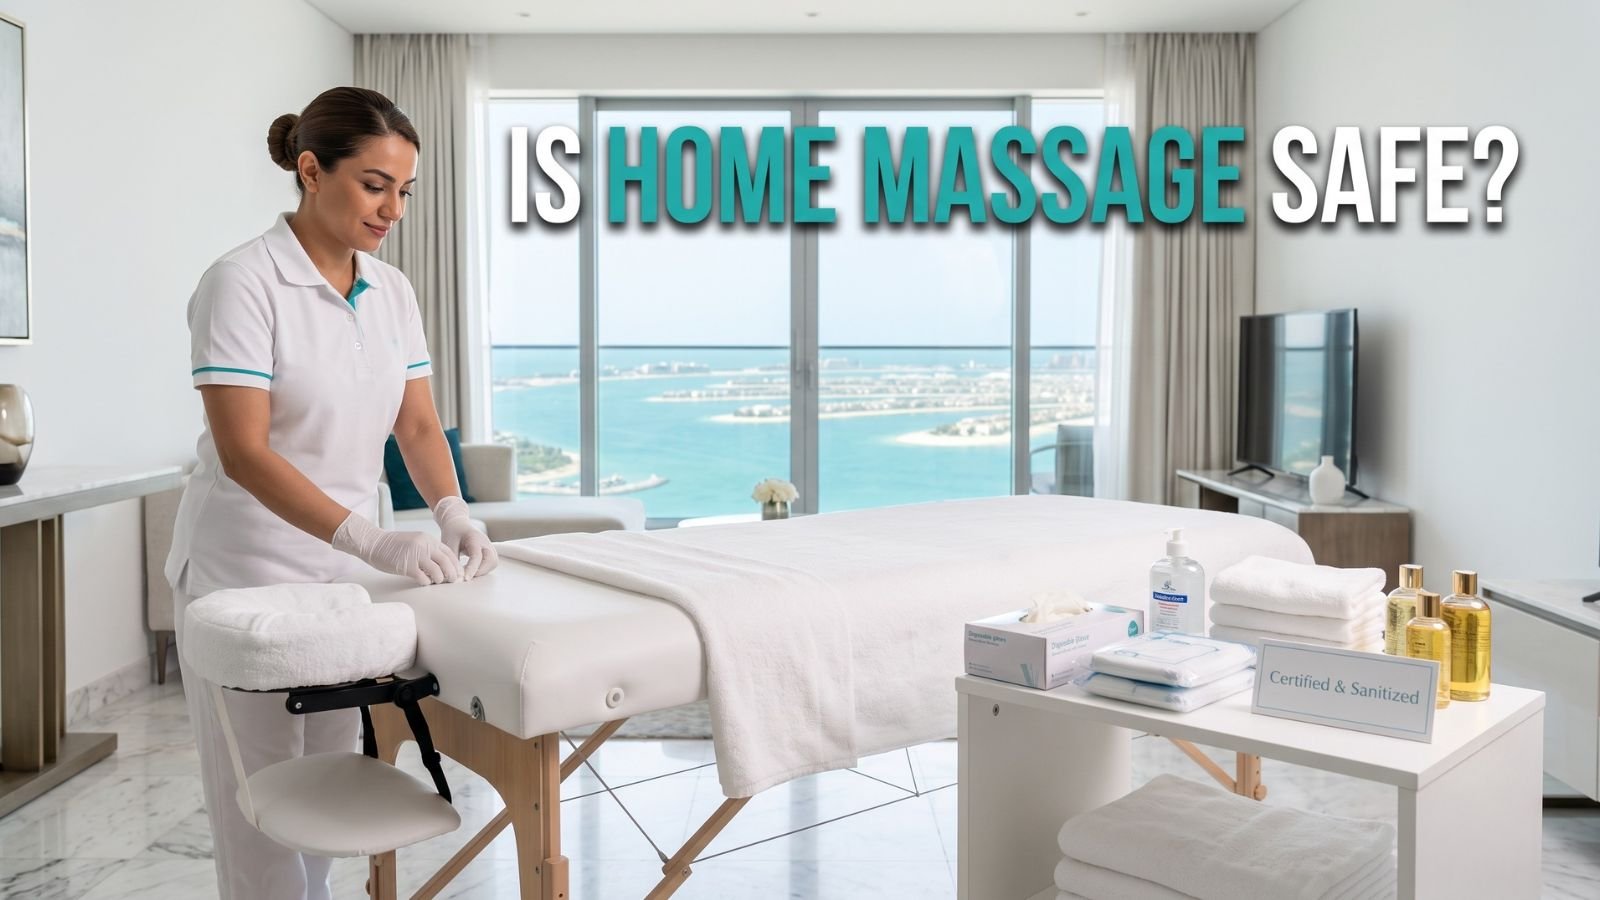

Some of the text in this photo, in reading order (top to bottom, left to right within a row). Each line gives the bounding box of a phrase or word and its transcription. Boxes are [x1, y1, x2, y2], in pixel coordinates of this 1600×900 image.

[1270, 670, 1419, 705] Certified & Sanitized
